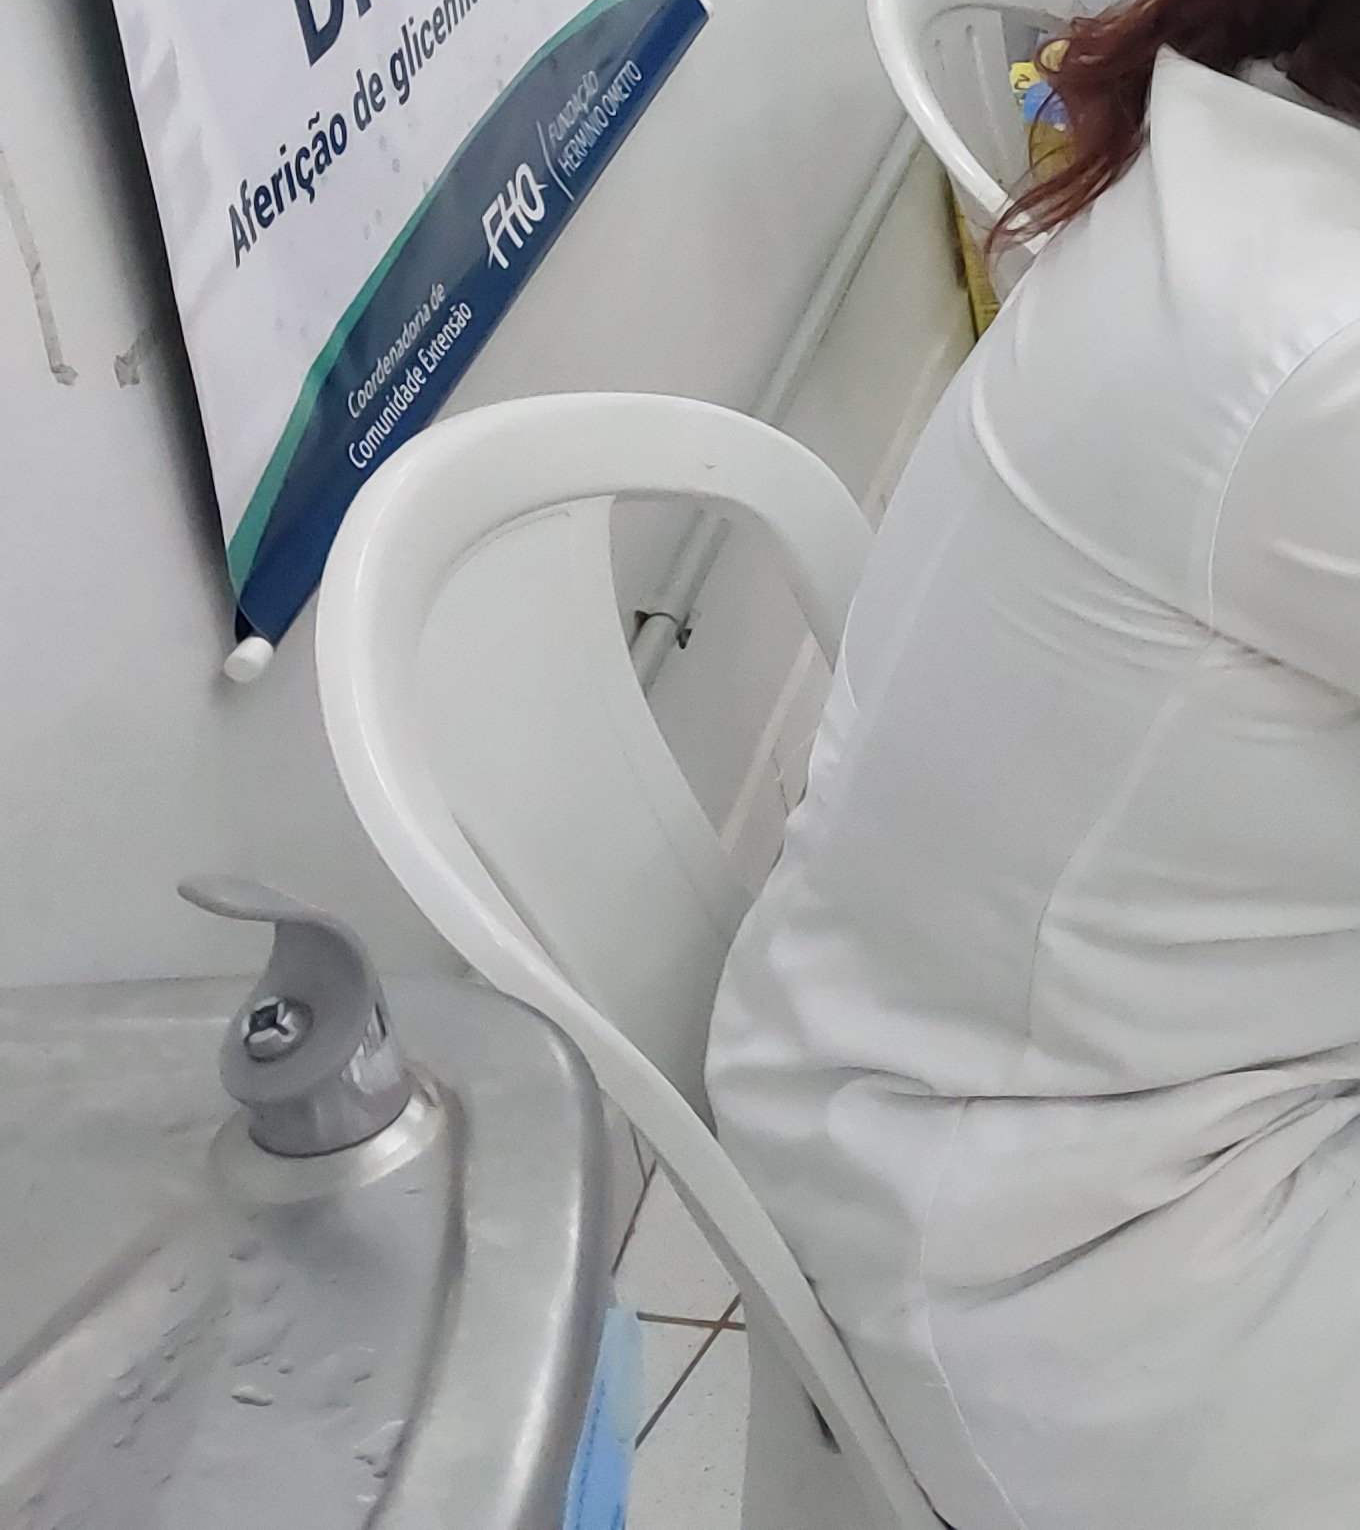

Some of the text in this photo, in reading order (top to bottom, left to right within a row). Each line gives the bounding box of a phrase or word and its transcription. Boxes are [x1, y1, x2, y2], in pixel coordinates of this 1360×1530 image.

[228, 111, 348, 269] Aferição
[353, 69, 387, 132] de
[481, 162, 548, 270] FHO
[347, 282, 447, 419] Coordenadoria de
[348, 302, 473, 469] Comunidade Extensão
